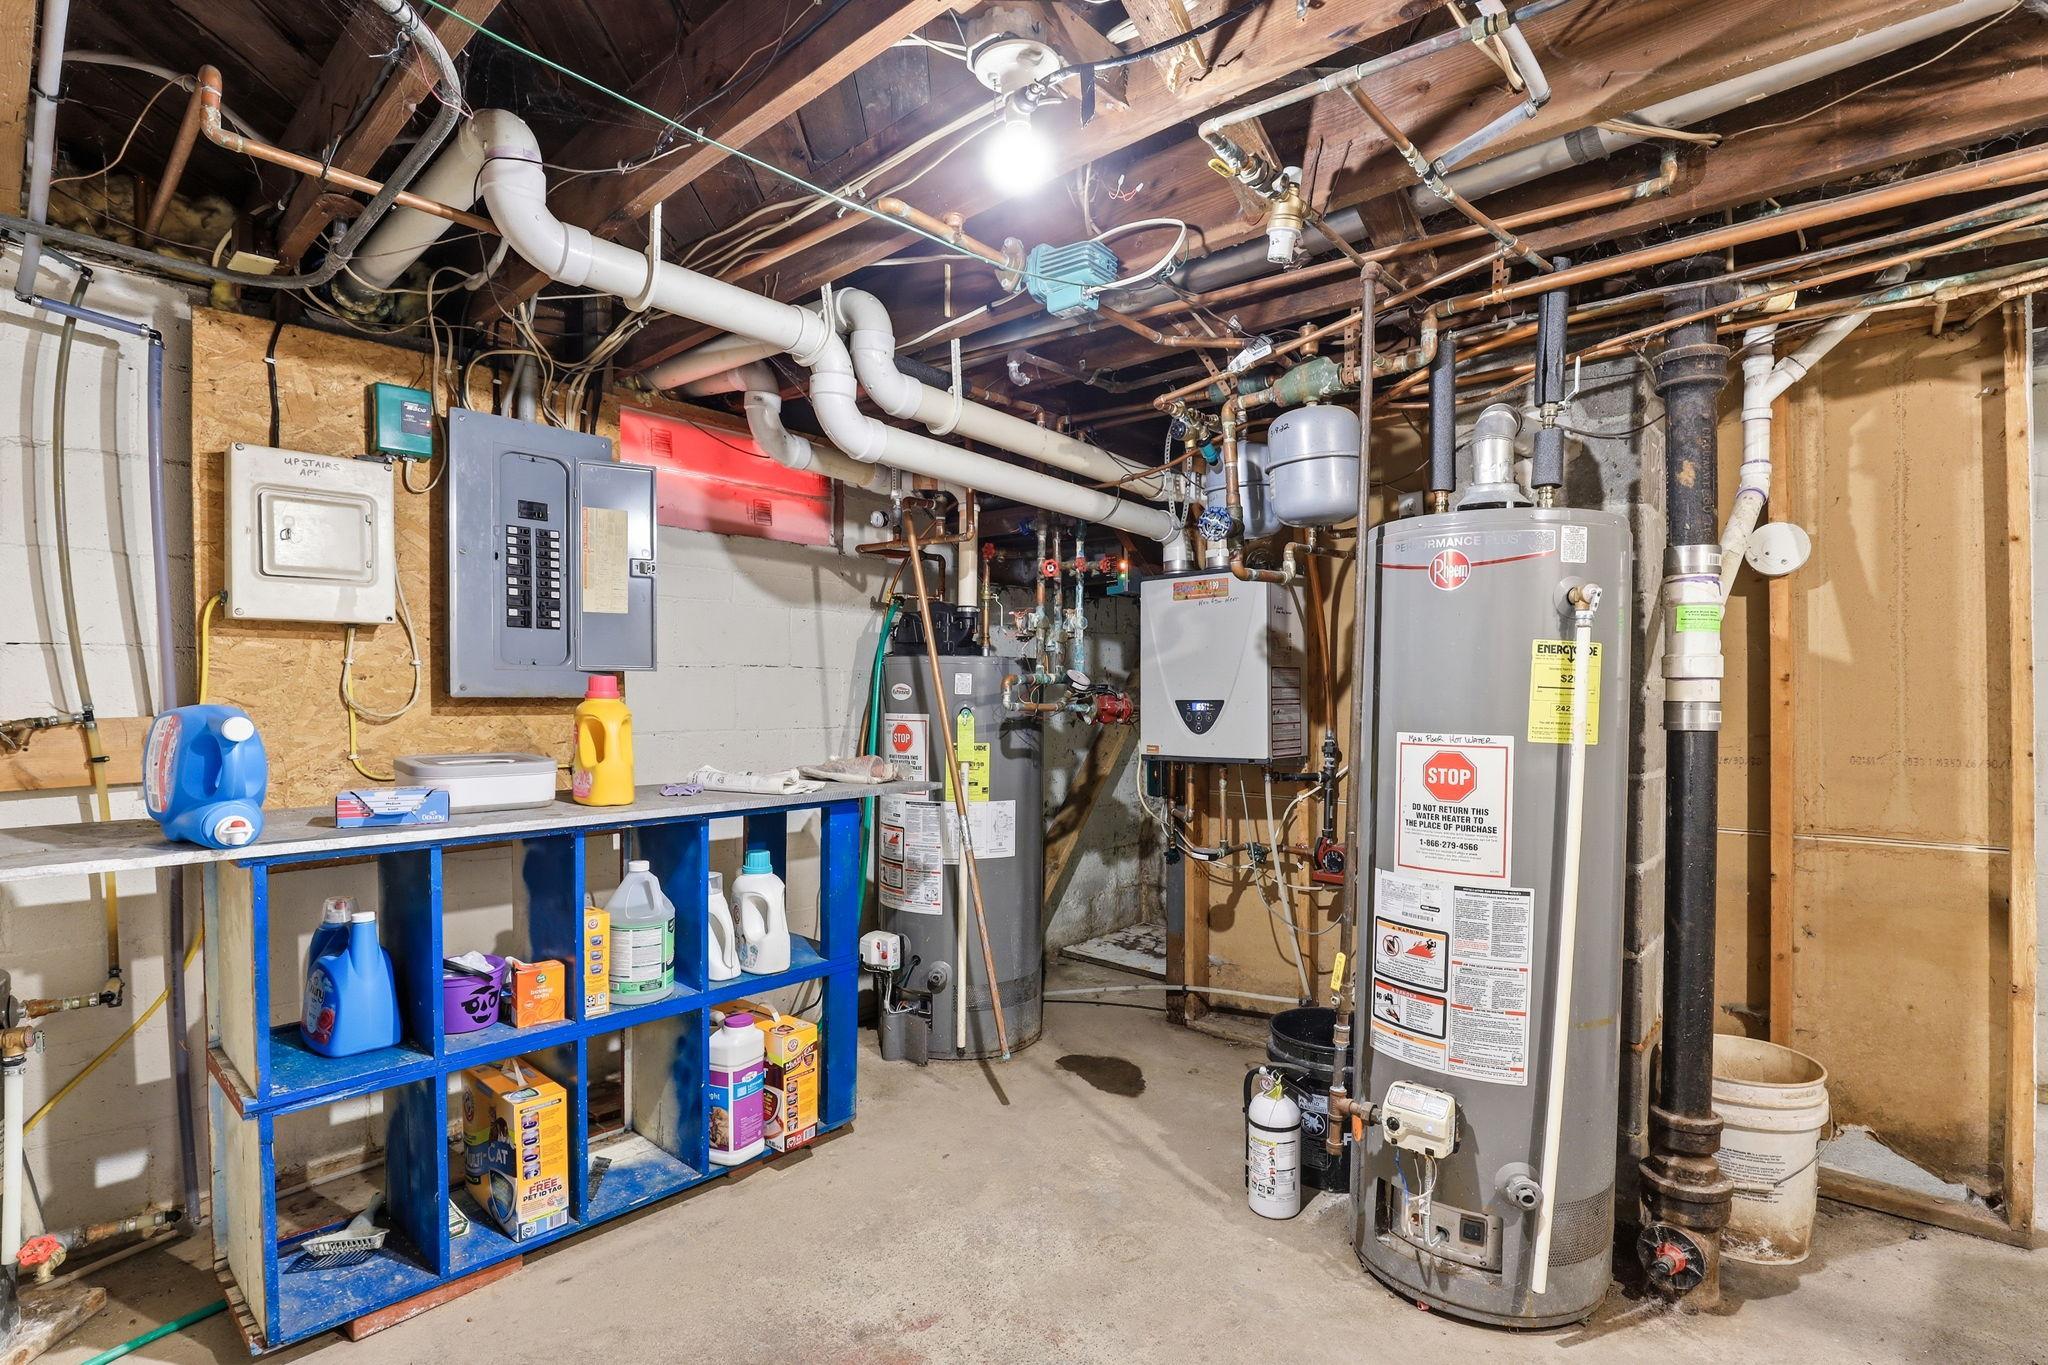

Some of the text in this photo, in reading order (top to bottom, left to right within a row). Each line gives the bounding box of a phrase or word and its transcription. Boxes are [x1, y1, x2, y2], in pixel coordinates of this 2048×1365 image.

[284, 457, 340, 471] UPSTAIRS
[1395, 536, 1481, 552] PEORMANCE
[1433, 550, 1468, 583] Rheem
[893, 732, 911, 744] STOP
[1427, 768, 1471, 785] STOP
[1412, 803, 1489, 816] DO NOT RETURN THIS
[1416, 812, 1484, 825] WATER HEATER TO
[1405, 819, 1498, 834] THE PLACE OF PURCHASE
[523, 1193, 537, 1202] PET
[548, 1184, 562, 1194] TAG
[529, 1178, 558, 1194] FREE
